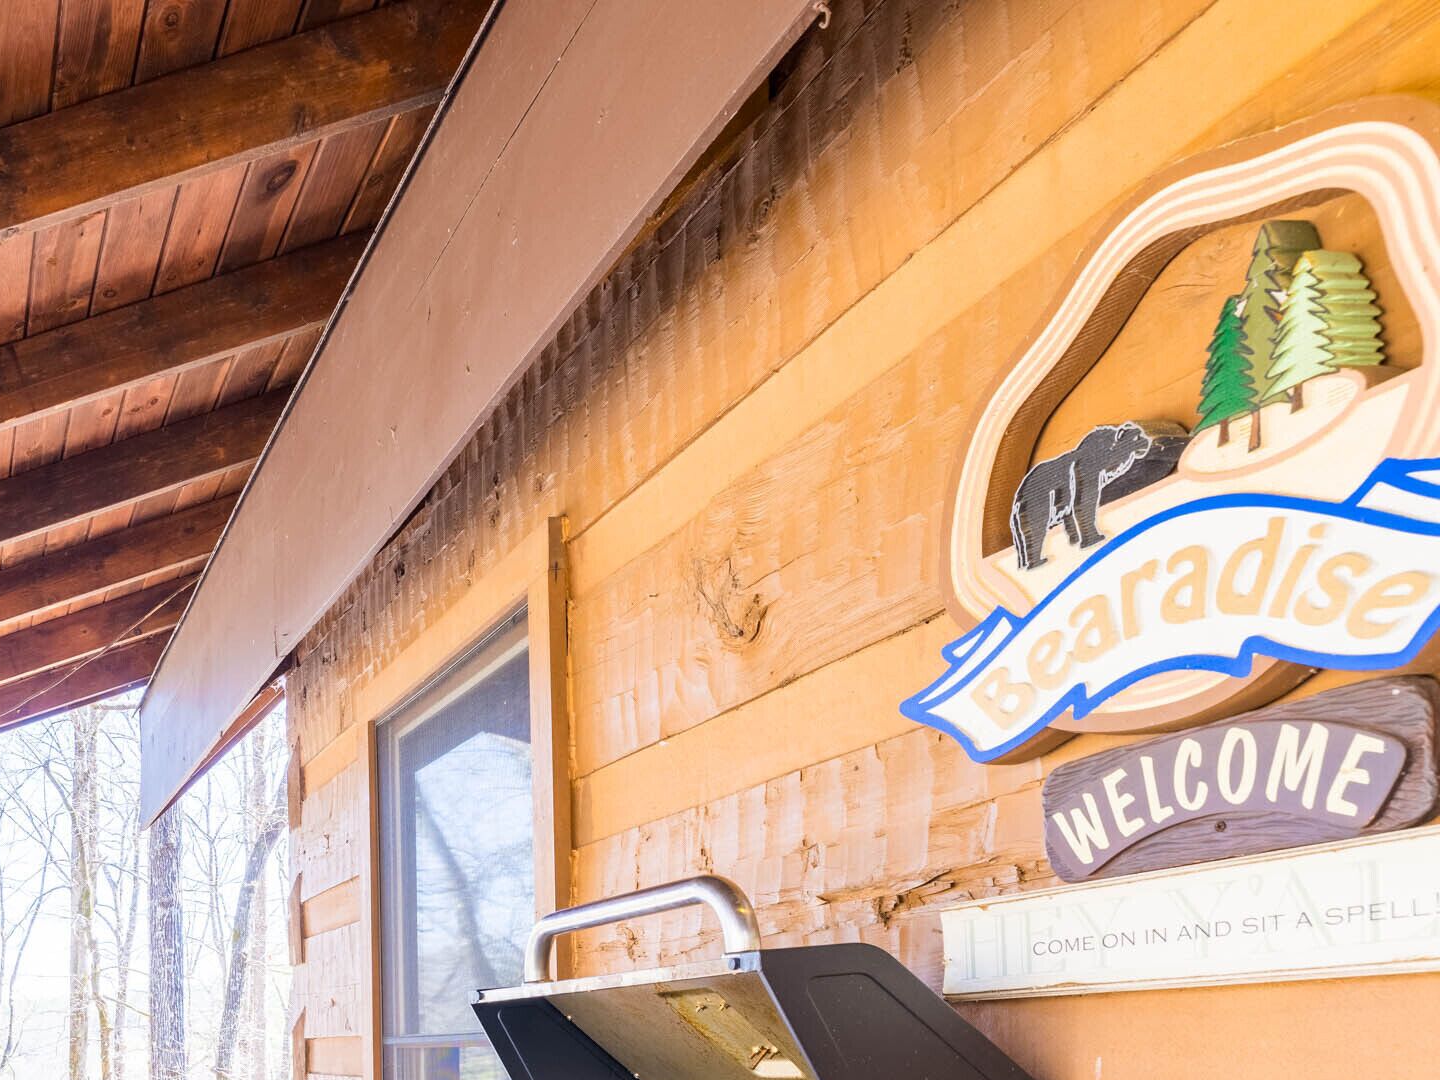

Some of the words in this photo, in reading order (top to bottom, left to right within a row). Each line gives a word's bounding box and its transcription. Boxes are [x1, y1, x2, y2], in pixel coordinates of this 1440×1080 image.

[968, 516, 1434, 732] Bearadise
[1052, 723, 1385, 865] WELCOME
[960, 896, 1129, 981] HEY
[1032, 936, 1096, 957] COME
[1101, 931, 1136, 948] ON
[1145, 927, 1168, 944] IN
[1177, 920, 1233, 940] AND
[1242, 914, 1282, 933] SIT
[1295, 911, 1314, 928] A
